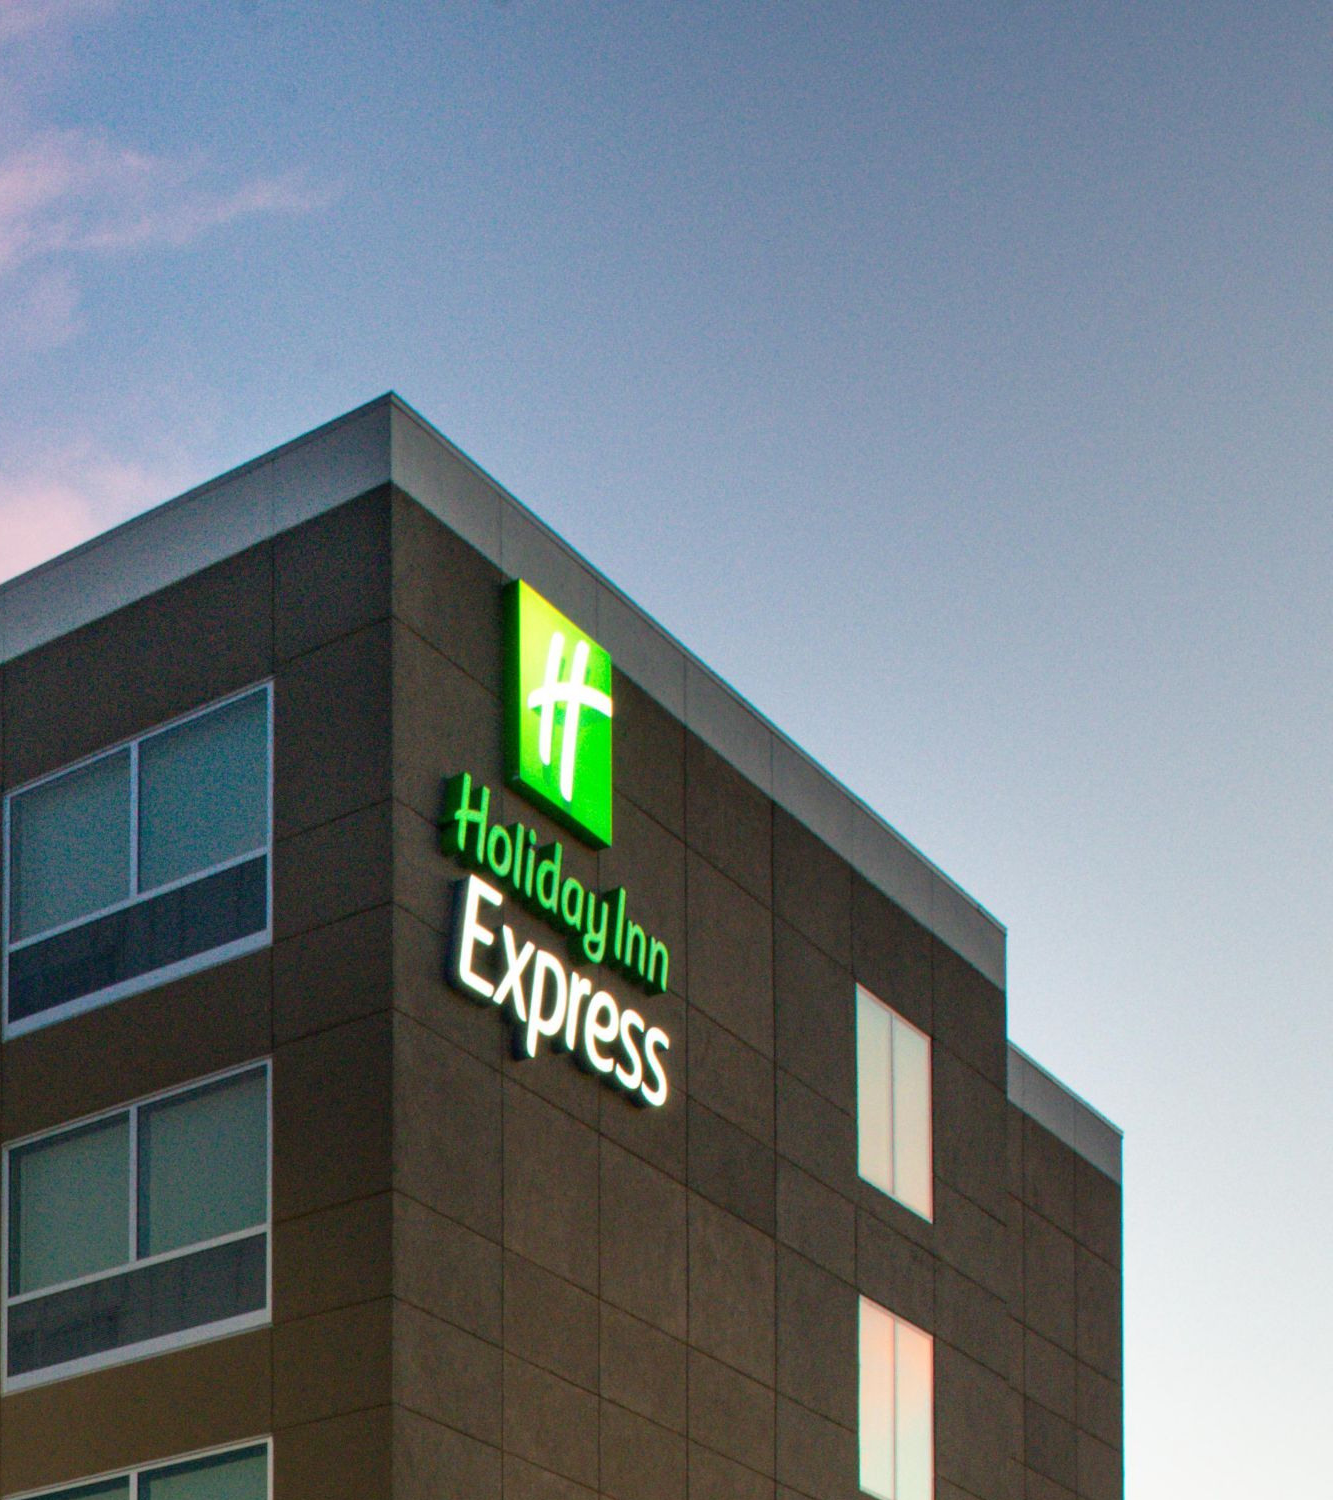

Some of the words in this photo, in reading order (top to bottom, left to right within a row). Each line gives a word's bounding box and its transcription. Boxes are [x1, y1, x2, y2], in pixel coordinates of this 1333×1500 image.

[454, 772, 609, 963] Holiday
[614, 887, 669, 993] Inn
[459, 874, 671, 1107] Express
